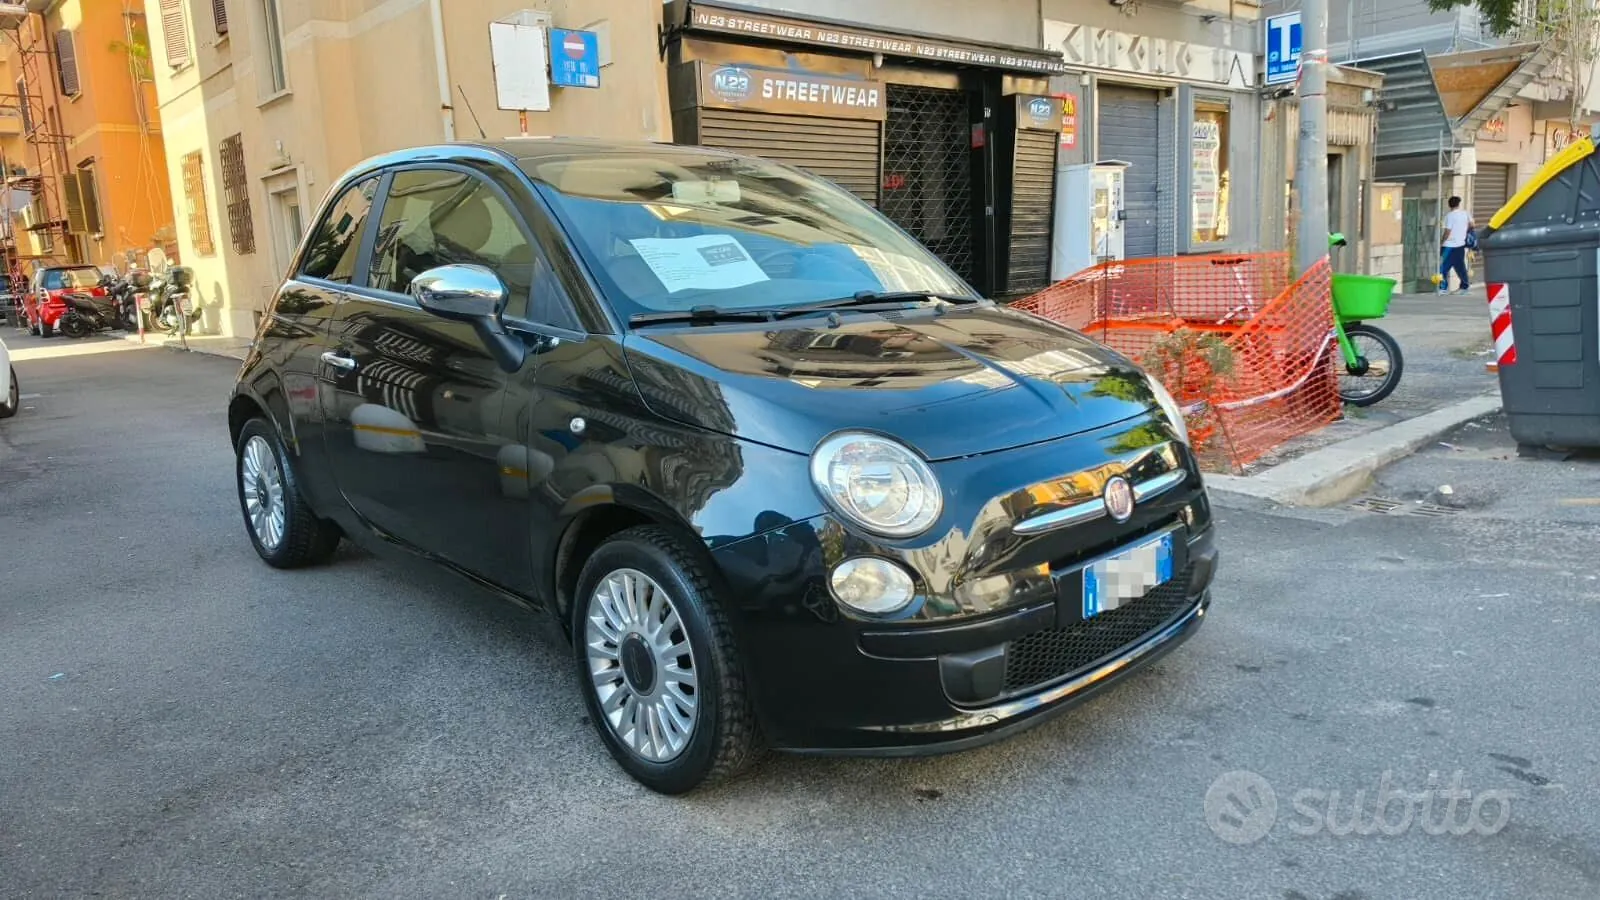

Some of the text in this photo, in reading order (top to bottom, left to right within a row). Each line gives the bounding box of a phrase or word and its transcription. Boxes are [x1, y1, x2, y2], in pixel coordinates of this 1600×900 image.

[727, 18, 812, 40] STREETWEAR
[817, 31, 839, 44] N23
[841, 36, 912, 54] STREETWEAR
[916, 45, 935, 56] N23
[937, 49, 997, 64] STREETWEAR
[762, 78, 879, 108] STREETWEAR
